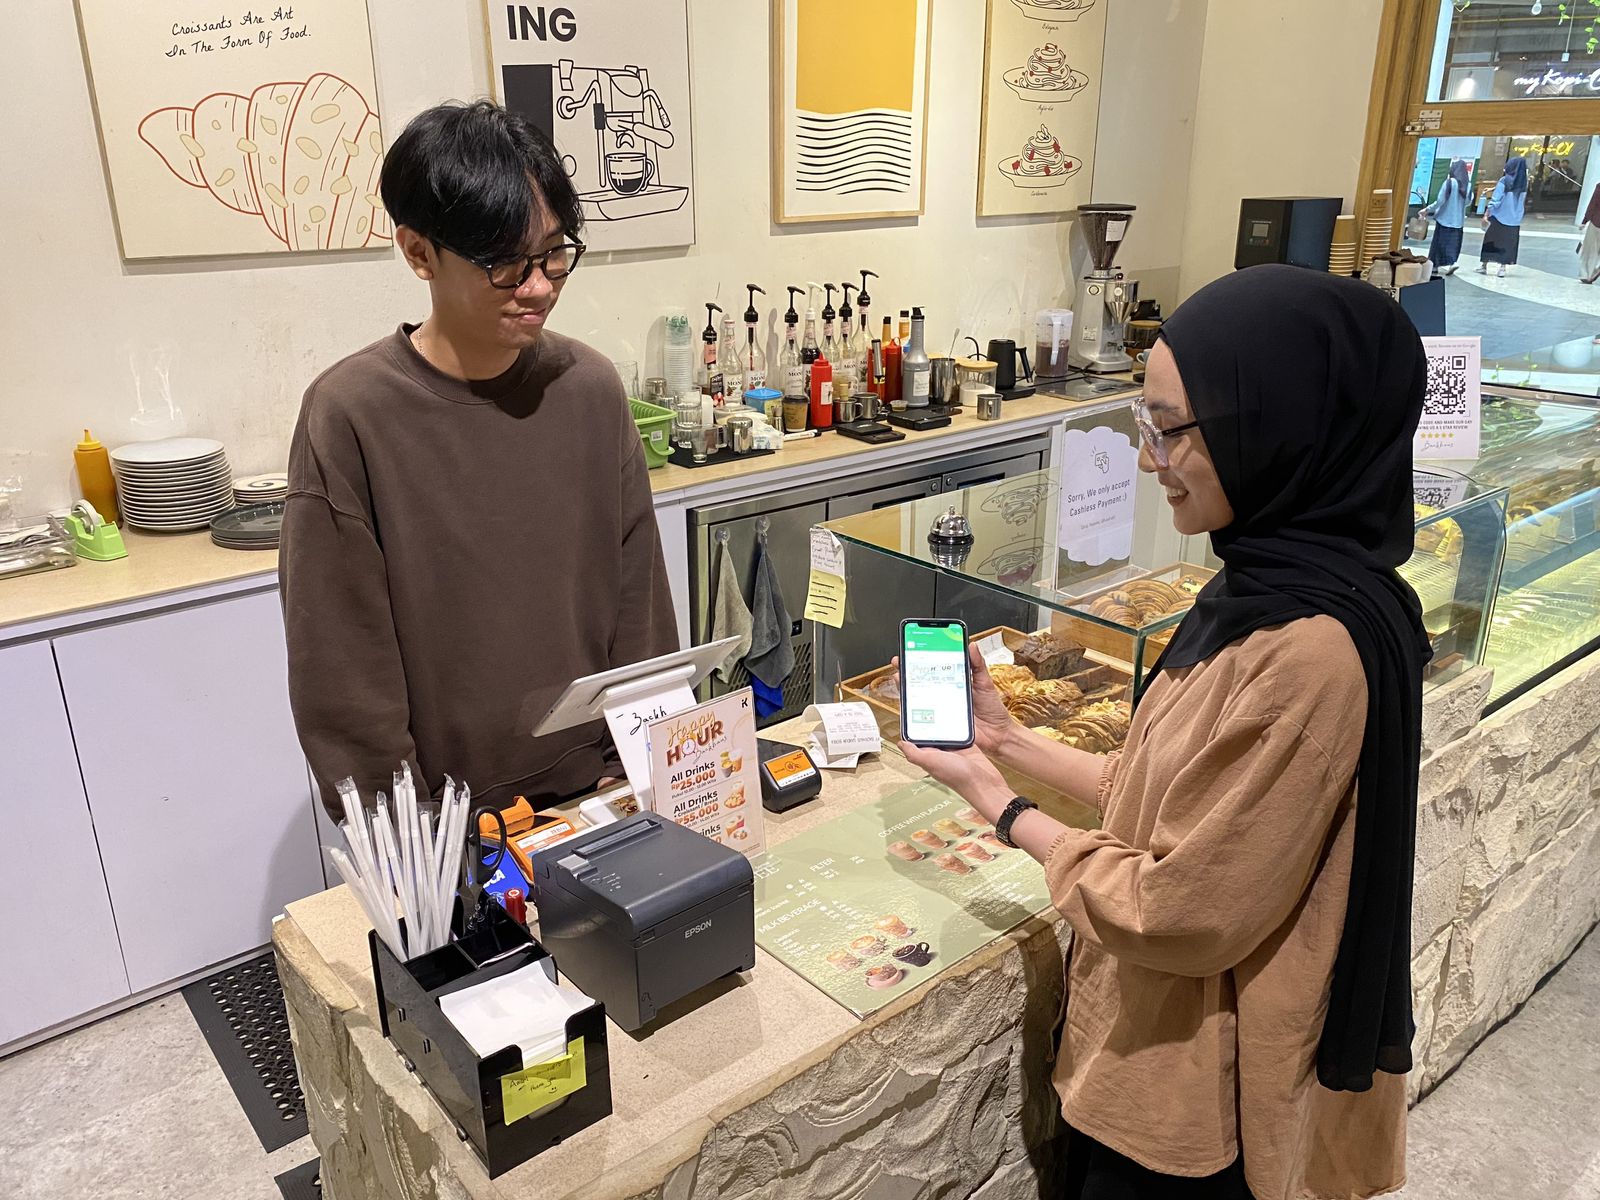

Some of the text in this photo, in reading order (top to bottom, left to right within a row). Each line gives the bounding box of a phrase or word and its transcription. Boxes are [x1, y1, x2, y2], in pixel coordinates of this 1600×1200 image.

[172, 6, 294, 36] Croissants Are Art
[506, 5, 577, 42] ING
[165, 25, 312, 57] In The Form Of Food.
[1086, 489, 1097, 498] We
[1098, 484, 1110, 494] only
[1111, 479, 1130, 491] accept
[1069, 503, 1096, 517] Cashless
[1097, 495, 1122, 509] Payment
[667, 711, 717, 748] Happy
[670, 761, 715, 784] All Drinks
[673, 791, 718, 814] All Drinks
[678, 805, 700, 817] Croissant
[878, 822, 904, 838] COFFEE
[809, 857, 834, 871] FILTER
[758, 920, 779, 934] MILK
[777, 898, 821, 922] BEVERAGE
[684, 919, 712, 939] EPSON
